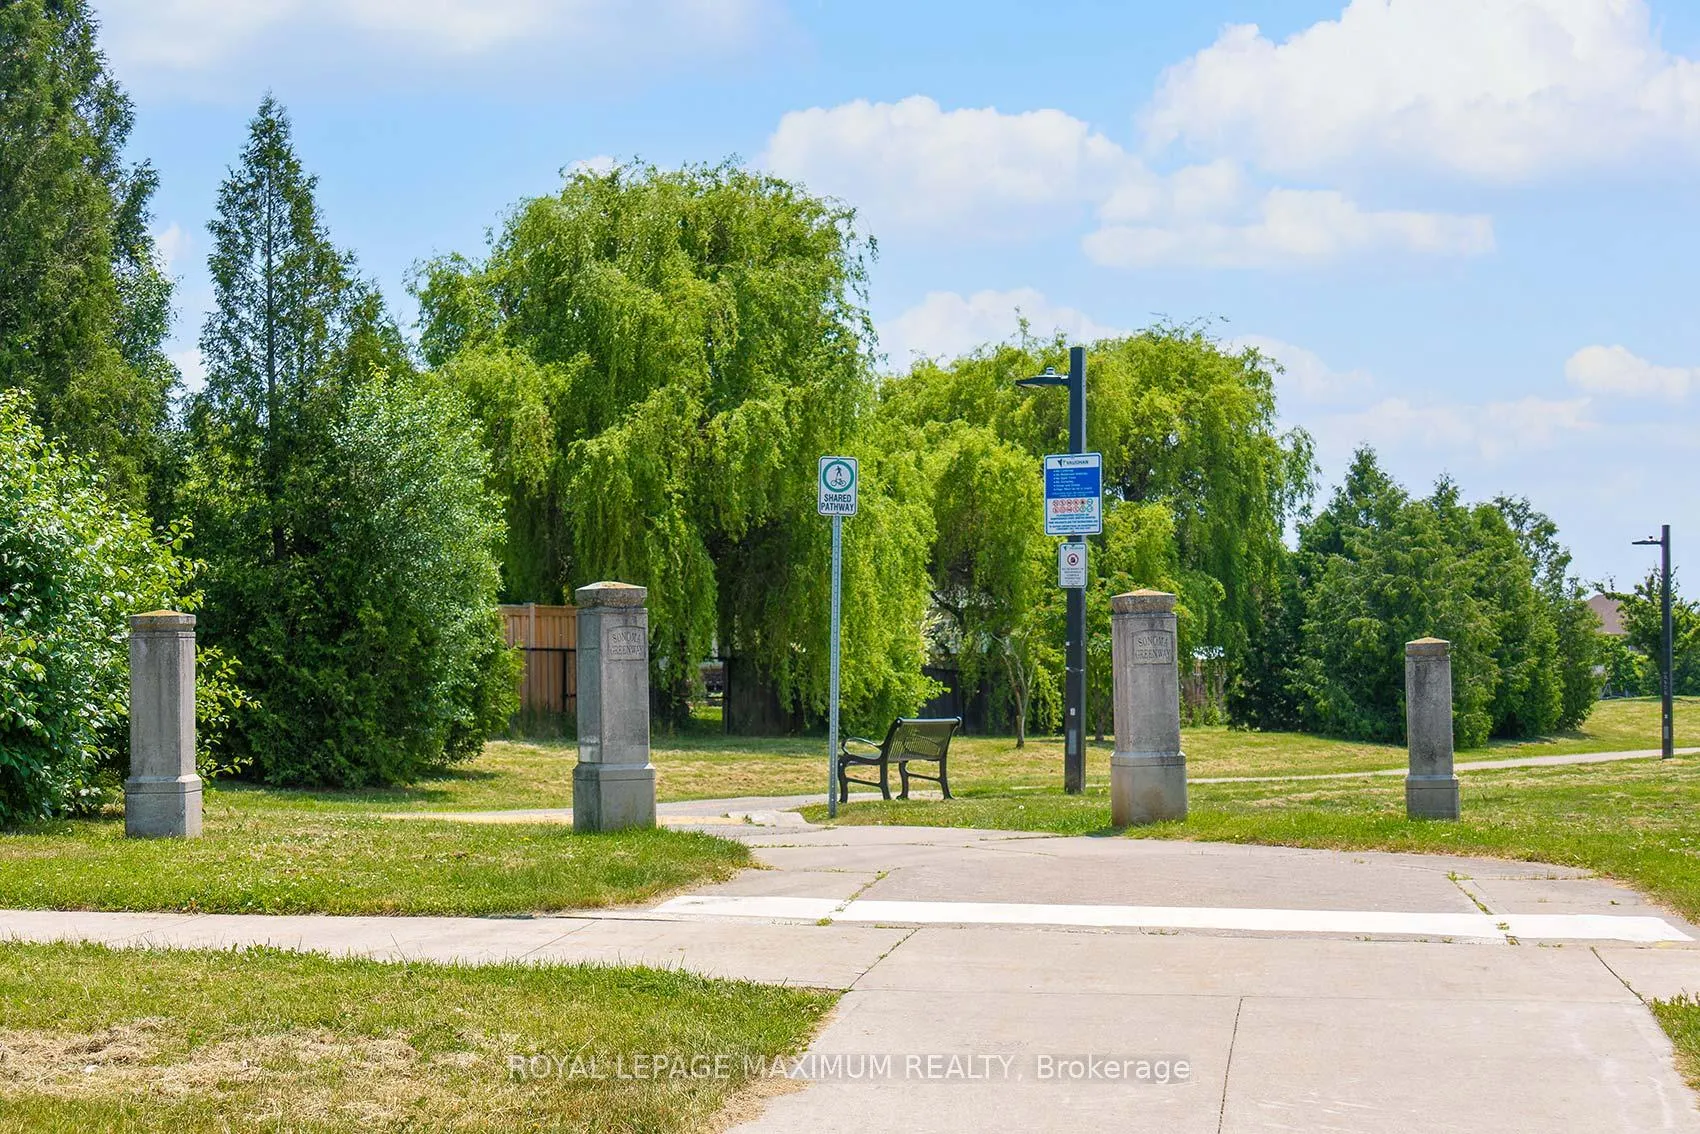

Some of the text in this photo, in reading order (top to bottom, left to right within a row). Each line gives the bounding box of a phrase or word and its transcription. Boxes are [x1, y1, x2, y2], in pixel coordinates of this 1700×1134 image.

[823, 494, 852, 503] SHARED
[820, 502, 854, 512] PATHWAY
[611, 631, 642, 643] SONOMA
[1137, 636, 1168, 647] SONOMA
[1135, 648, 1171, 659] GREENWAY
